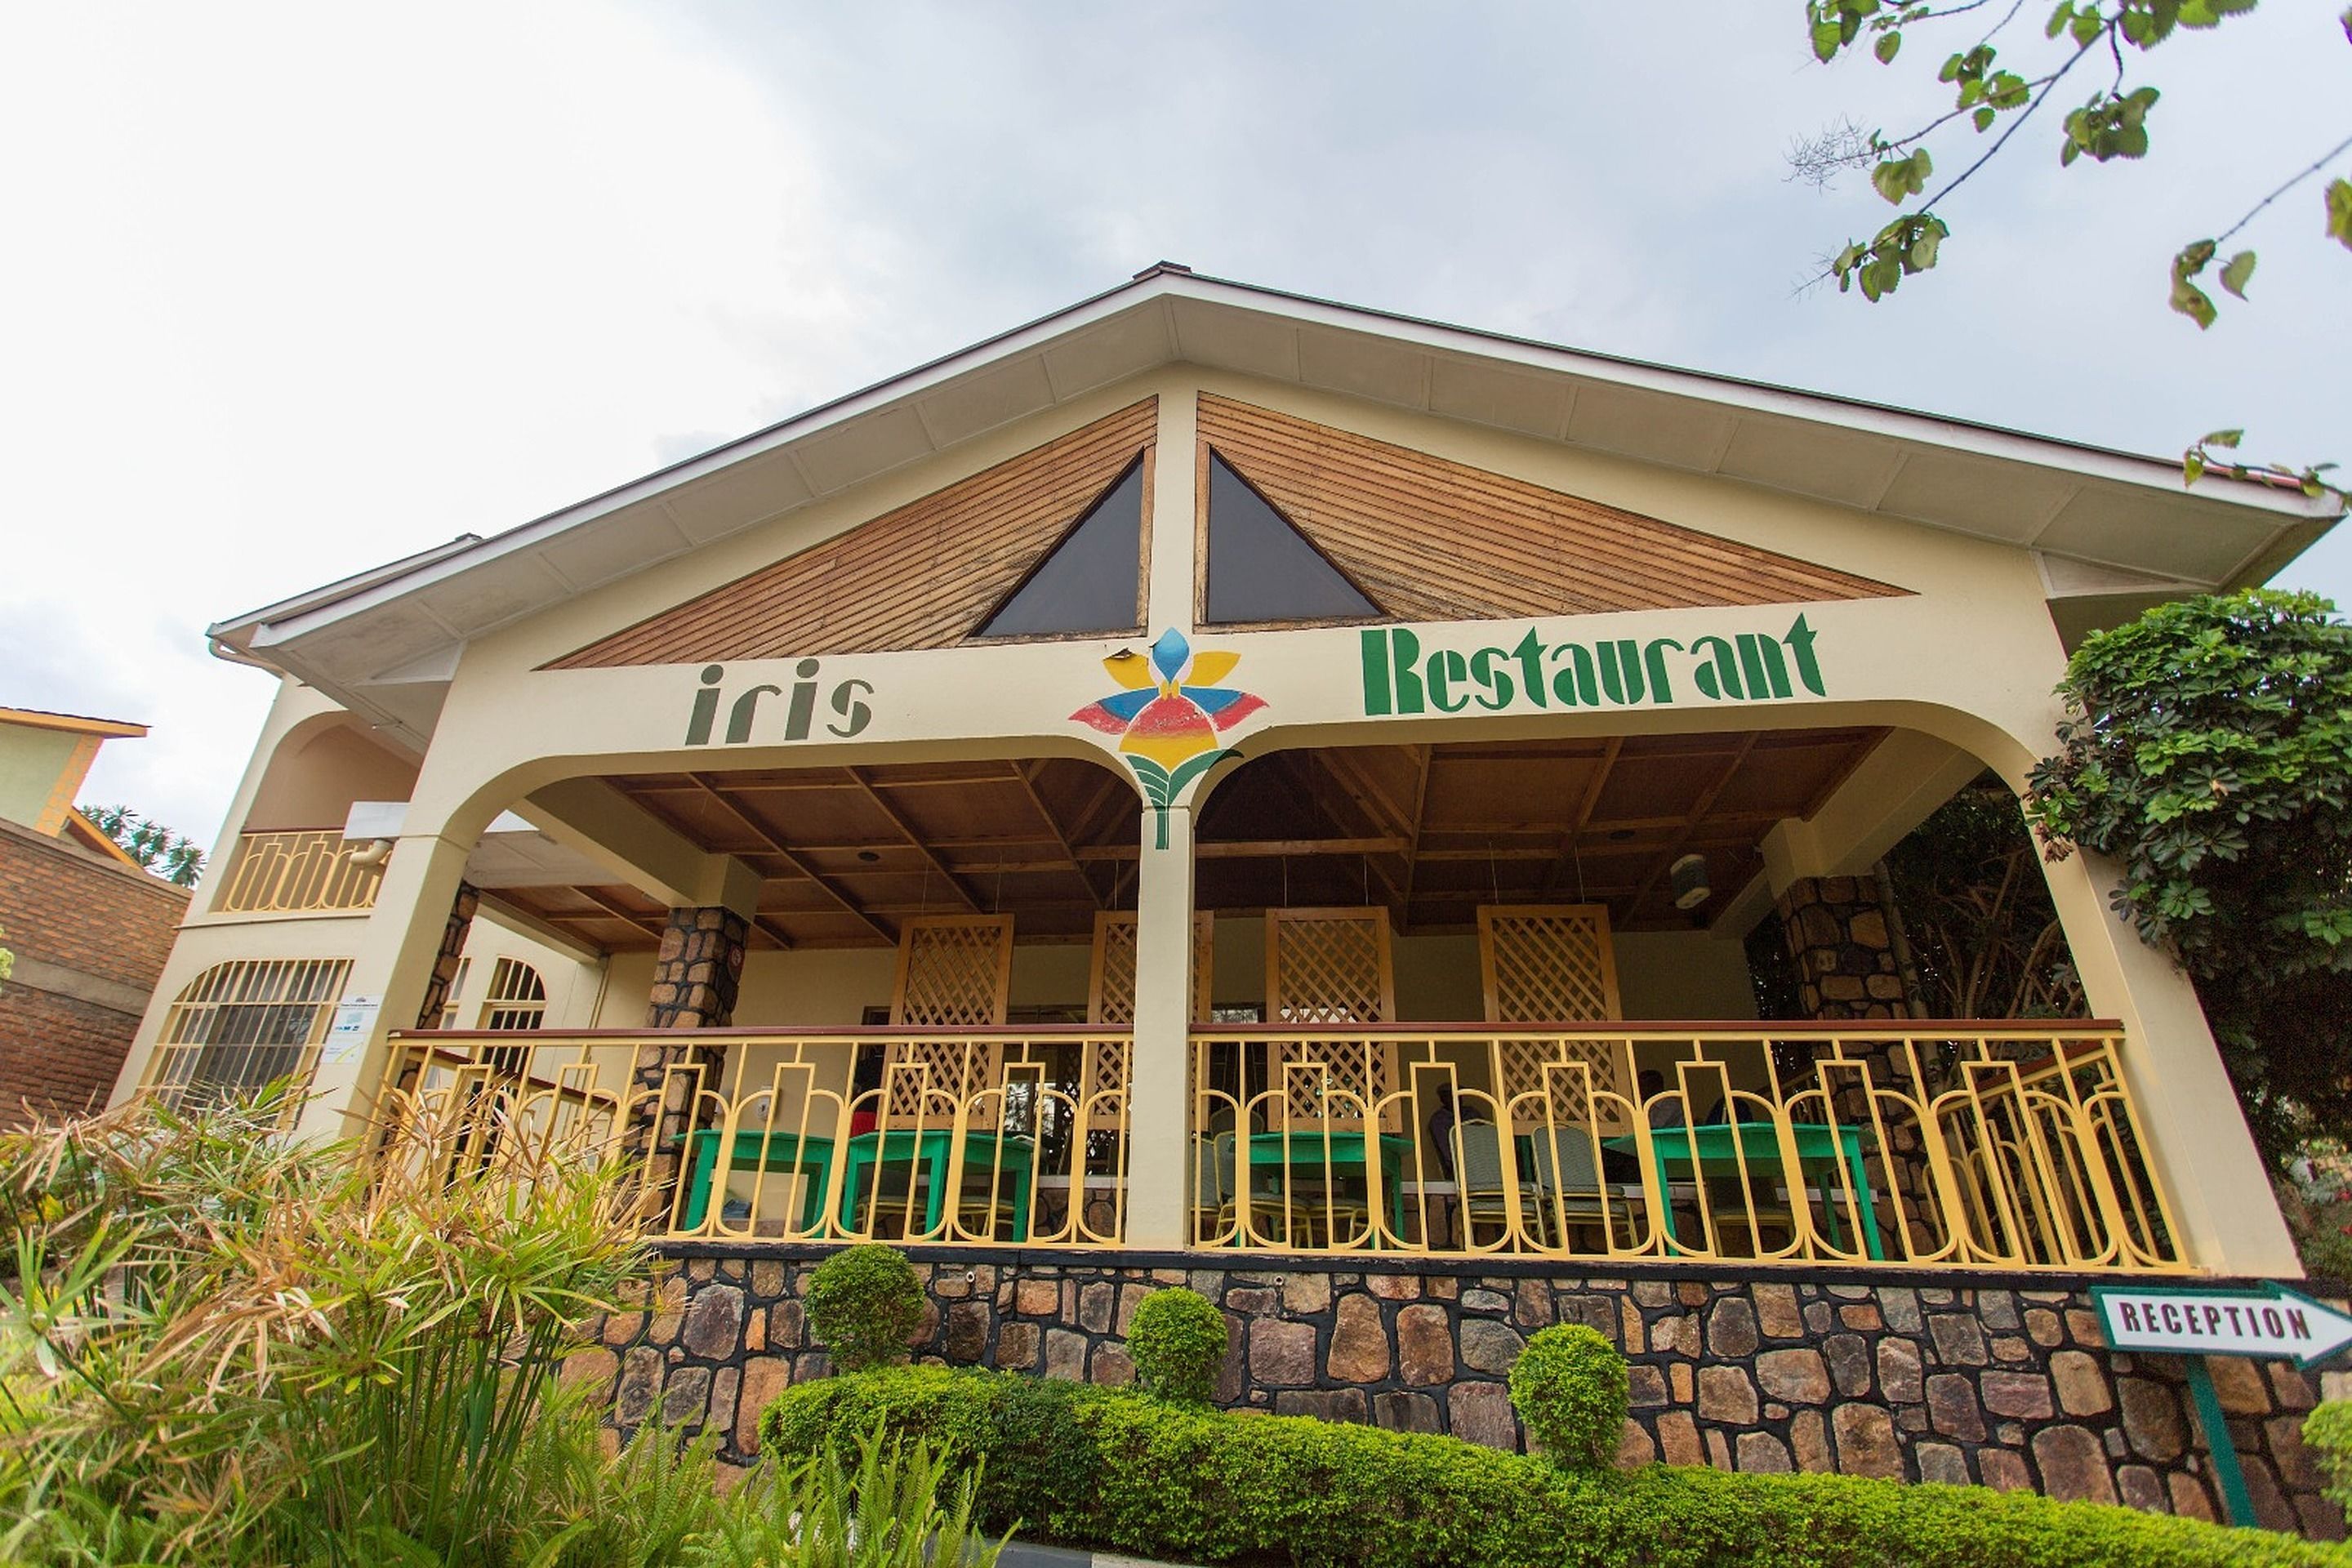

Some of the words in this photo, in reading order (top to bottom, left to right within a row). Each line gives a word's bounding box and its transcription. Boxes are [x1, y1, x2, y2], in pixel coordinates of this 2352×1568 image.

[685, 657, 875, 746] iris
[1361, 612, 1826, 715] Restaurant
[2118, 1302, 2312, 1339] RECEPTION
